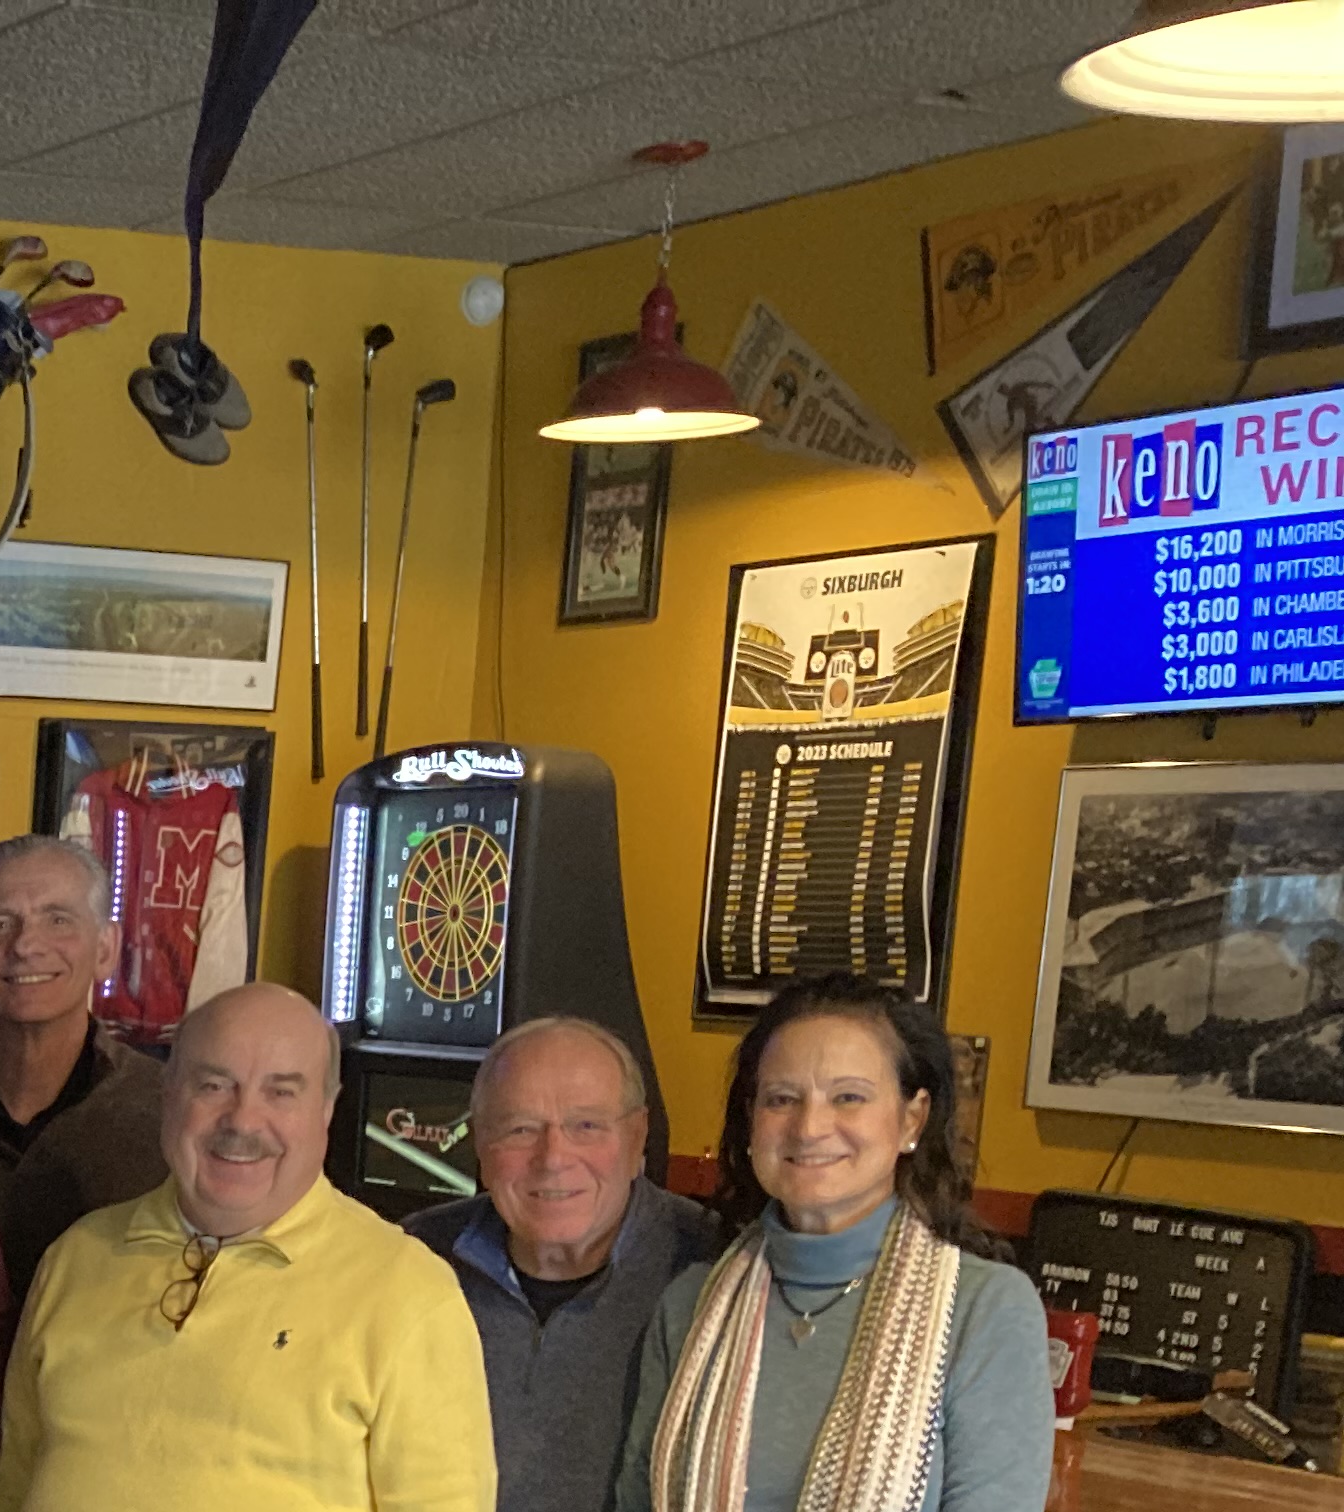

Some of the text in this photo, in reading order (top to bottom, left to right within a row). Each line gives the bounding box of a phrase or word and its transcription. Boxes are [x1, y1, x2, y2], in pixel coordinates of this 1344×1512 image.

[1101, 438, 1220, 521] keno
[1155, 518, 1344, 565] $16,200 IN MORRIS
[821, 569, 904, 596] SIXBURGH
[1026, 574, 1066, 595] 1:20
[1153, 562, 1241, 597] $10,000
[1254, 561, 1272, 584] IN
[1163, 595, 1240, 629] $3,600
[1252, 596, 1270, 618] IN
[1161, 624, 1344, 662] $3,000 IN CARLISL
[830, 657, 854, 679] Lite
[1163, 662, 1237, 695] $1,800
[1249, 664, 1268, 686] IN
[796, 740, 894, 762] 2023 SCHEDULE
[453, 804, 470, 818] 20
[150, 825, 218, 911] M
[387, 873, 399, 888] 14
[384, 905, 394, 919] 11
[405, 987, 414, 1002] 7
[1194, 1252, 1230, 1273] WEEK
[1169, 1282, 1202, 1301] TEAM
